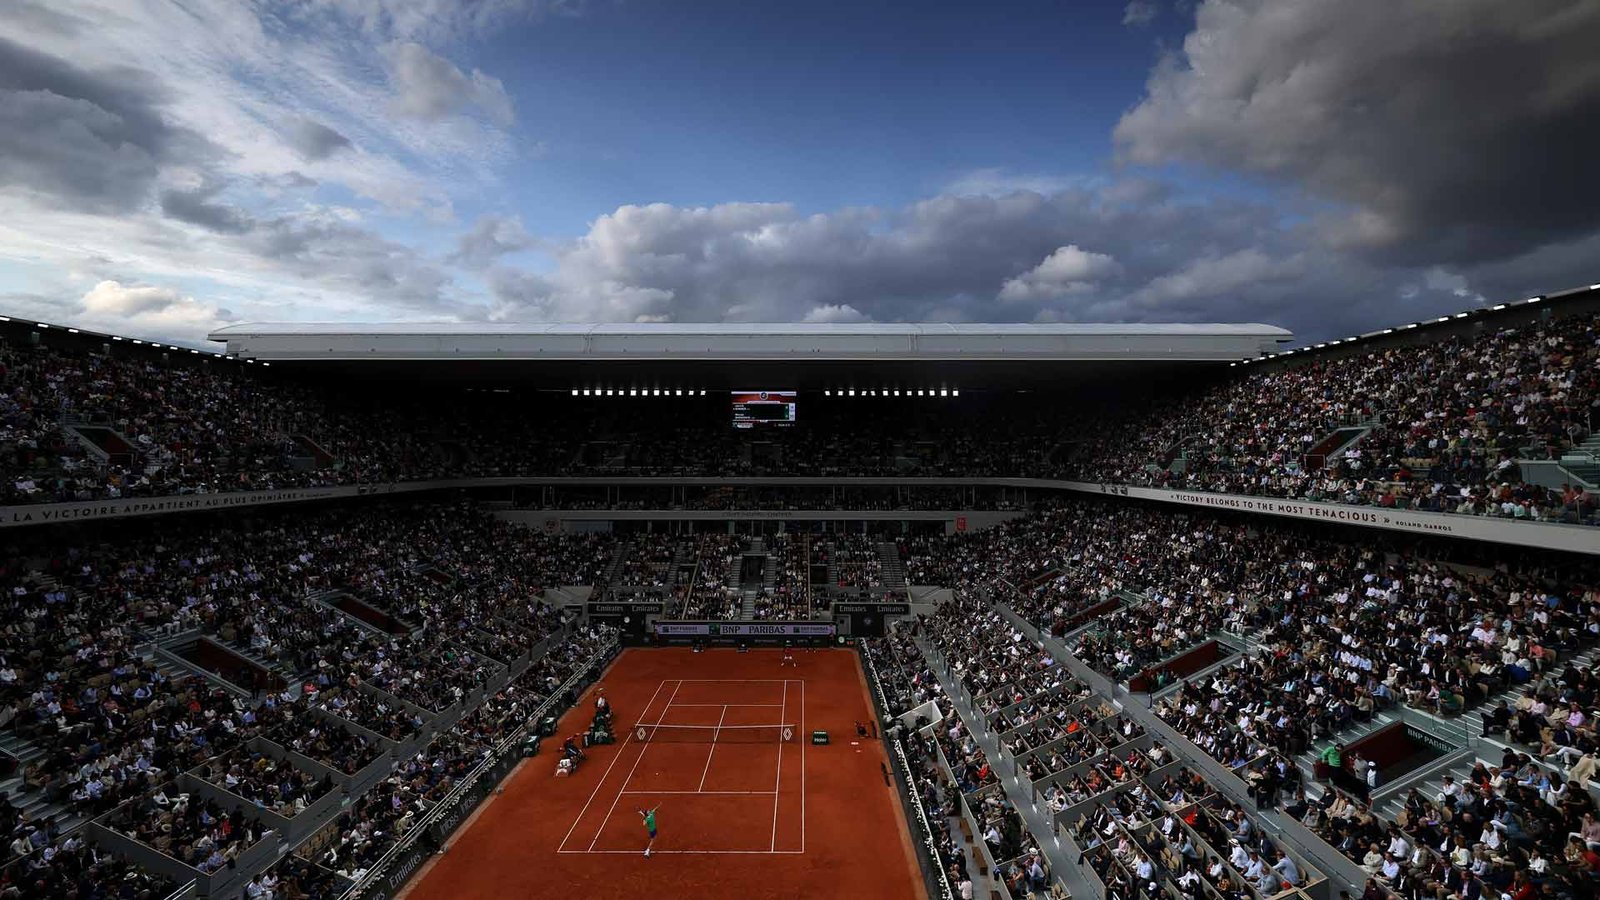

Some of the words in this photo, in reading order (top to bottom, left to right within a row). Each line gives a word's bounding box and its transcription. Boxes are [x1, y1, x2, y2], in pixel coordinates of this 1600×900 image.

[13, 512, 33, 522] LA
[43, 506, 117, 520] VICTOIRE
[124, 500, 200, 513] APPARTIENT
[206, 499, 218, 507] AU
[224, 497, 247, 505] PLUS
[1176, 494, 1203, 503] VICTORY
[1206, 497, 1240, 507] BELONGS
[1243, 501, 1253, 509] TO
[1257, 502, 1274, 511] THE
[1278, 504, 1304, 514] MOST
[1309, 507, 1377, 523] TENACIOUS
[1396, 520, 1422, 528] ROLAND
[1424, 523, 1452, 532] GARROS
[722, 625, 741, 634] BNP
[748, 625, 786, 634] PARIBAS
[1407, 728, 1423, 739] BNP
[388, 853, 421, 889] Emirates
